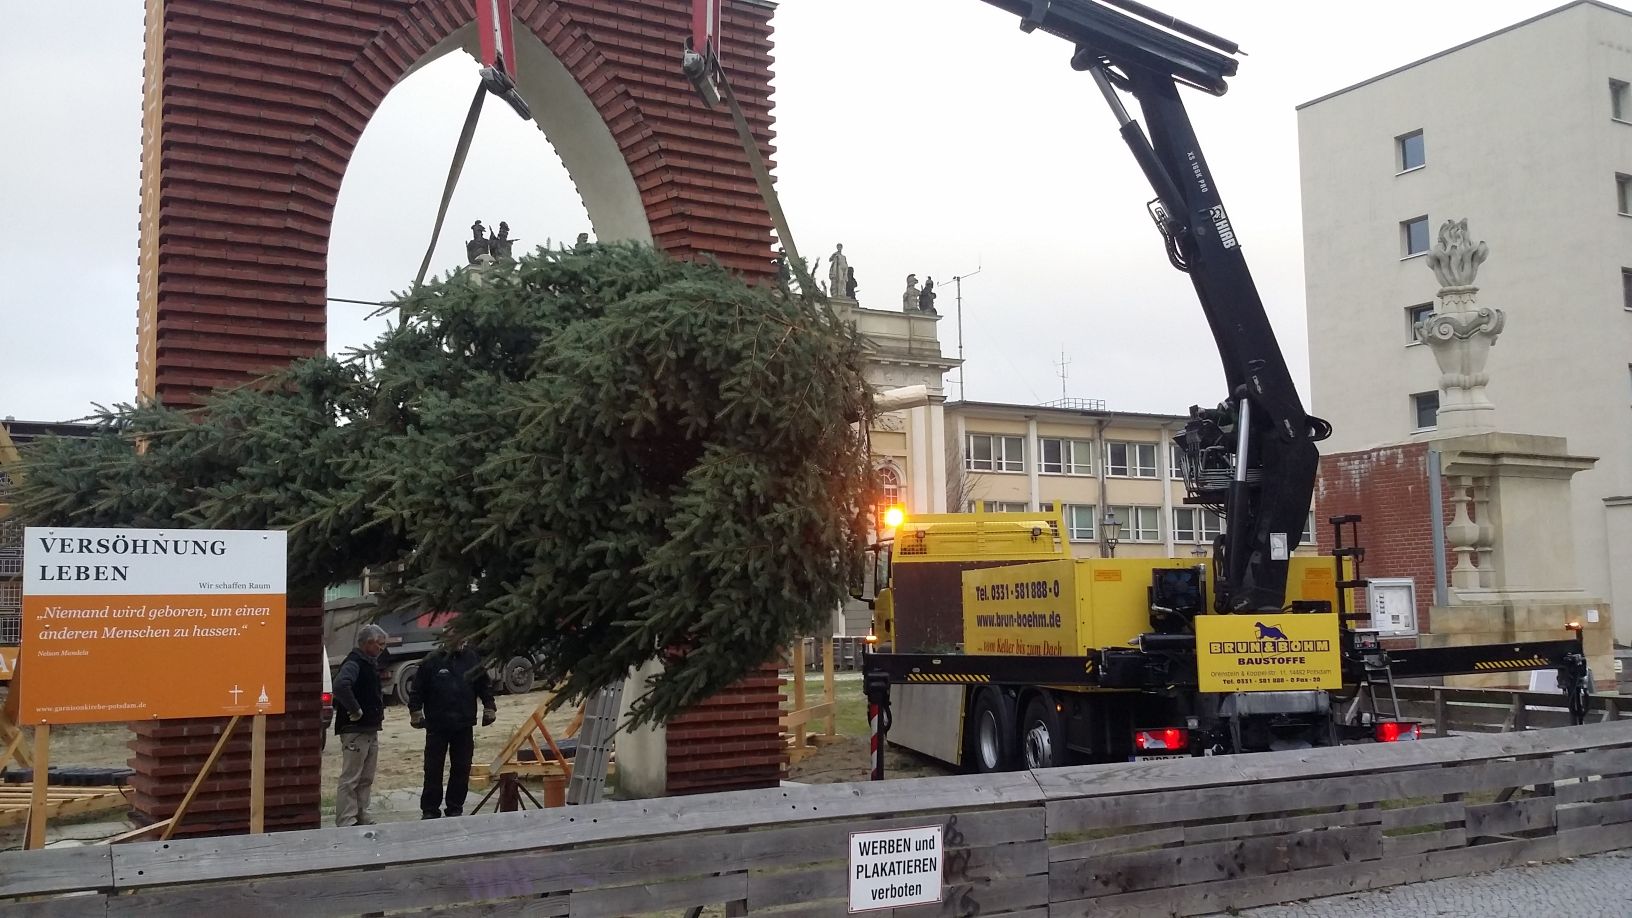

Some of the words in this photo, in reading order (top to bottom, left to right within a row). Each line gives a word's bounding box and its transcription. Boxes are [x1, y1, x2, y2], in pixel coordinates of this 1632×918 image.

[1187, 151, 1196, 161] XS
[1198, 179, 1208, 193] PRO
[1215, 219, 1236, 249] HIAB
[39, 534, 227, 556] VERSÖHNUNG
[39, 565, 129, 581] LEBEN
[199, 582, 213, 590] Wir
[215, 581, 247, 590] schaffen
[249, 582, 271, 590] Raum
[976, 585, 990, 601] Tel.
[37, 606, 110, 621] „Niemand
[112, 606, 145, 619] wird
[148, 606, 207, 621] geboren,
[211, 607, 232, 618] um
[235, 605, 270, 617] einen
[976, 610, 1061, 628] www.brun-boehm.de
[39, 626, 98, 640] anderen
[101, 625, 171, 640] Menschen
[173, 627, 189, 638] zu
[37, 649, 60, 658] Nelson
[60, 649, 89, 657] Mandela
[997, 638, 1015, 654] Keller
[1016, 638, 1025, 655] bis
[1026, 644, 1041, 656] zum
[1043, 640, 1063, 656] Dach
[1238, 656, 1306, 665] BAUSTOFFE
[36, 701, 147, 713] www.garnisonkirche-potsdam.de
[859, 838, 911, 856] WERBEN
[915, 835, 935, 851] und
[856, 857, 937, 879] PLAKATIEREN
[871, 883, 922, 901] verboten
